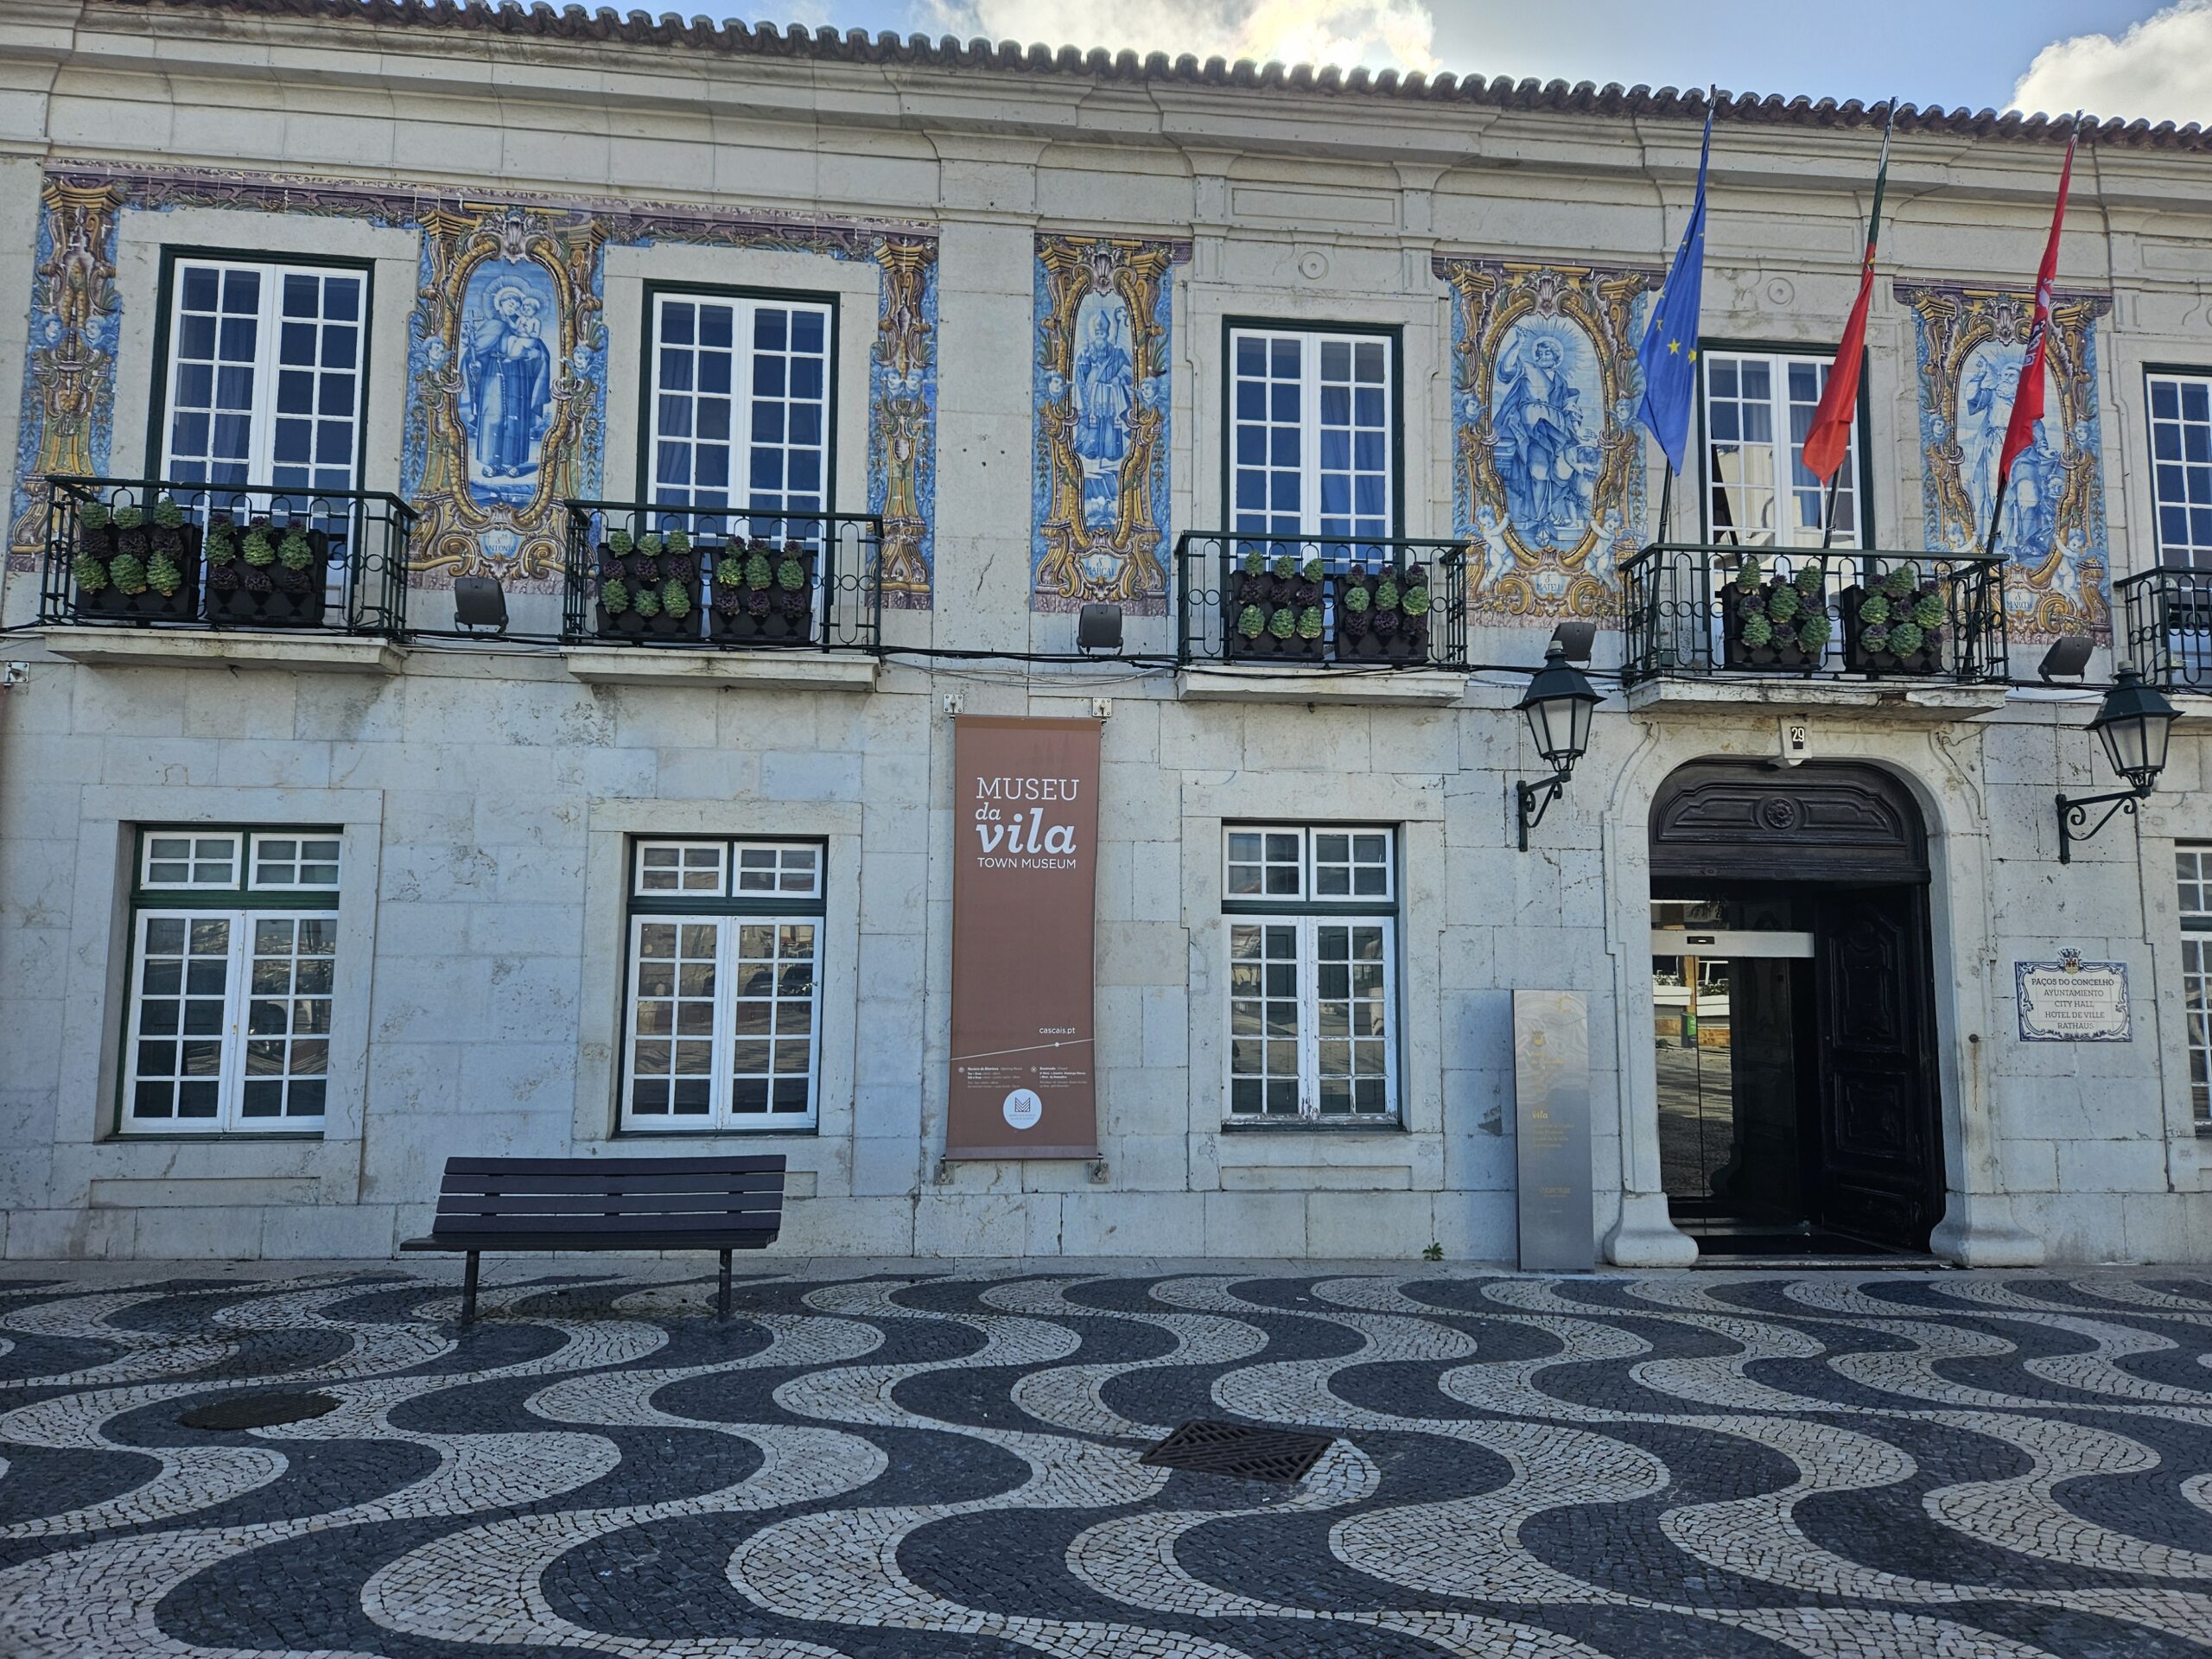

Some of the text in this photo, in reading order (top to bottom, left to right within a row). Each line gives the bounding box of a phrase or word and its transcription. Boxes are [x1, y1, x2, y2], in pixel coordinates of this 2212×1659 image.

[1791, 727, 1805, 742] 29
[976, 777, 1079, 801] MUSEU
[975, 802, 1001, 821] da
[976, 807, 1077, 854] vila
[977, 857, 1077, 869] TOWN MUSEUM
[2031, 978, 2057, 987] PAÇOS
[2071, 978, 2114, 987] CONCELHO
[1039, 1027, 1076, 1035] cascais.pt
